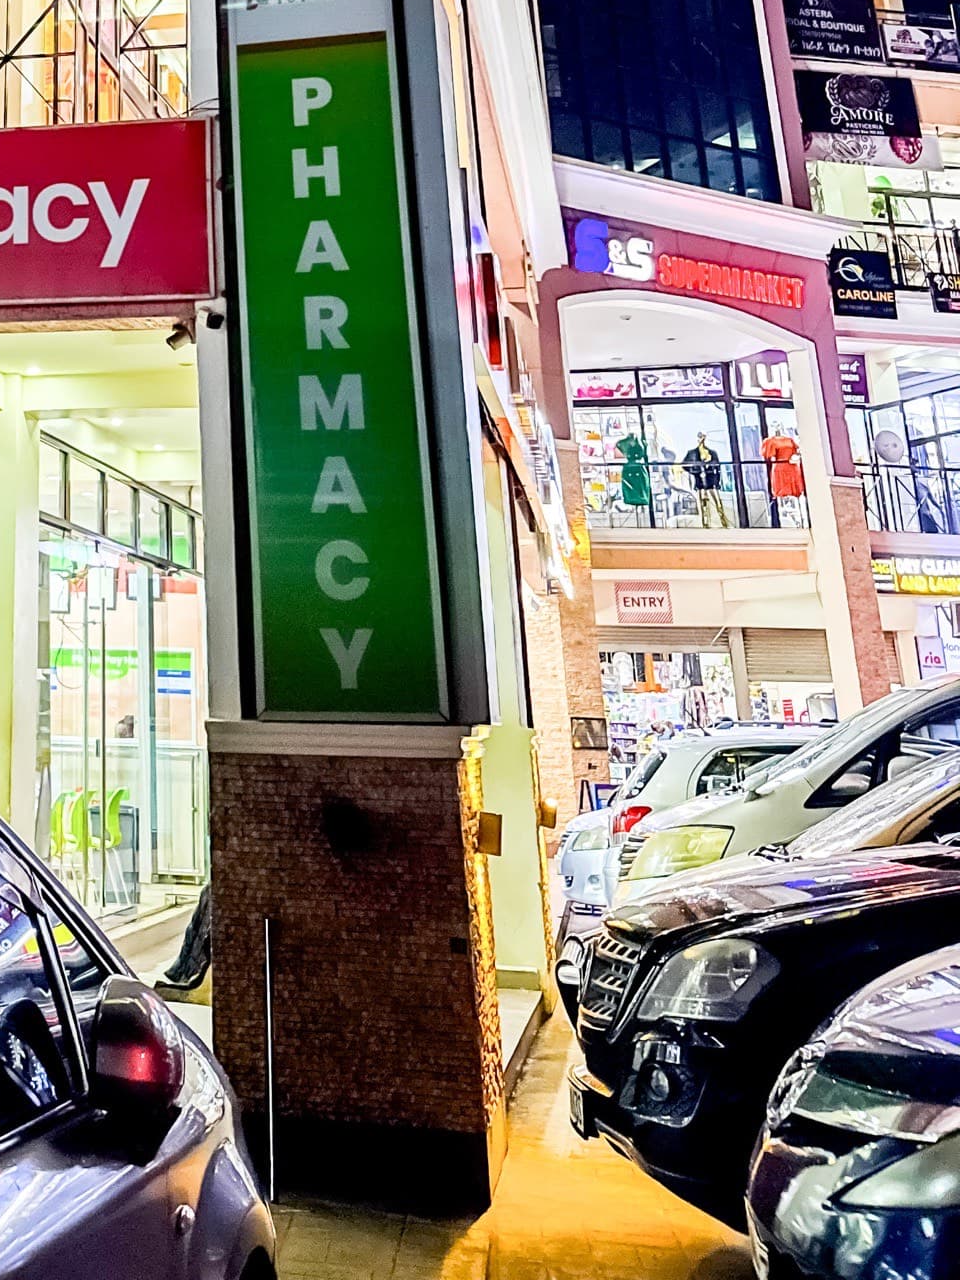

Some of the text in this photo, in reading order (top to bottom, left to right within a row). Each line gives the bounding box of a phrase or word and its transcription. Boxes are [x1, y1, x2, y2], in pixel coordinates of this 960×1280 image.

[799, 8, 833, 19] ASTERA
[812, 20, 819, 28] &
[820, 21, 865, 33] BOUTIQUE
[830, 105, 894, 126] AMORE
[657, 253, 806, 309] SUPERMARKET
[837, 289, 895, 303] CAROLINE
[290, 76, 375, 690] PHARMACY
[623, 596, 665, 608] ENTRY
[925, 651, 942, 664] ria
